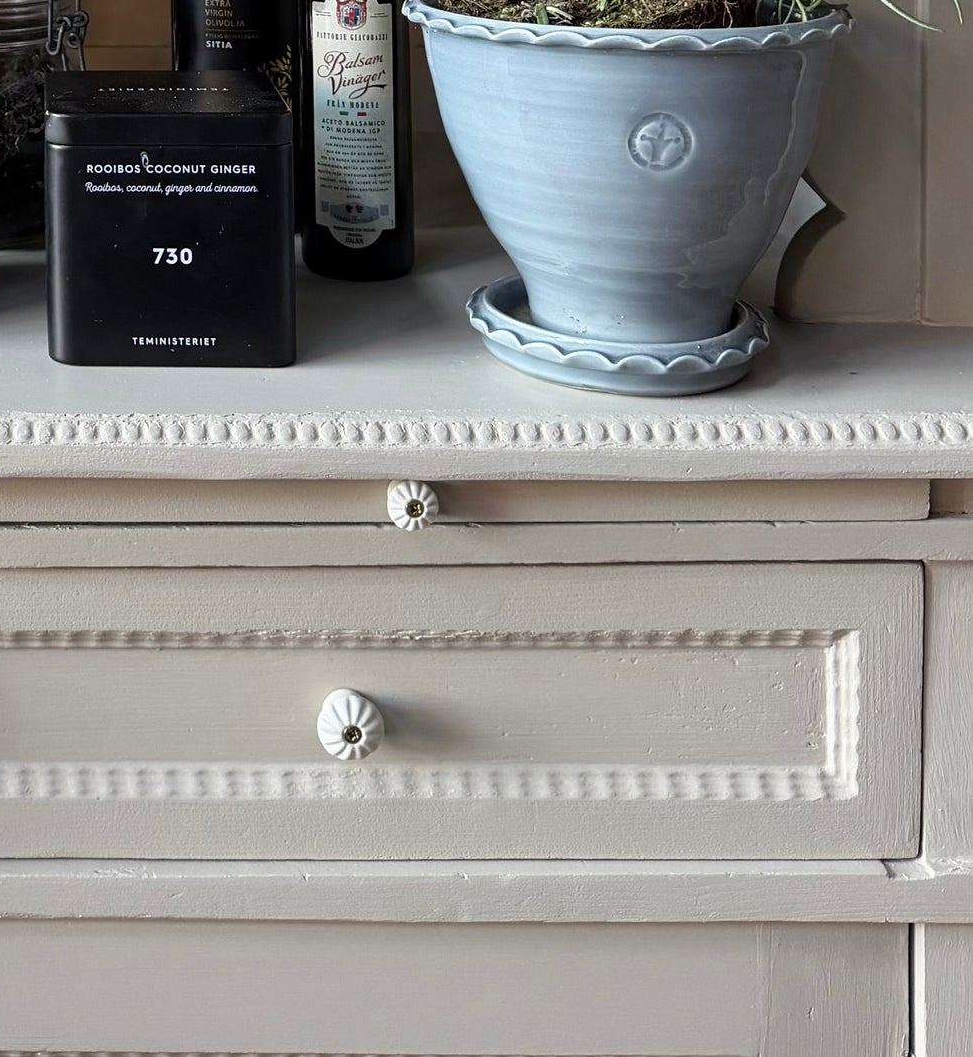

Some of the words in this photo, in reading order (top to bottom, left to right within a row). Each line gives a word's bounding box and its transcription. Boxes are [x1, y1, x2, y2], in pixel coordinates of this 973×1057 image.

[204, 0, 232, 8] EXTRA
[205, 9, 233, 18] VIRGIN
[205, 40, 233, 49] SITIA
[317, 50, 384, 78] Balsam
[329, 69, 387, 100] Vinäger
[326, 99, 345, 108] FRÅN
[350, 101, 379, 109] MODENA
[321, 118, 343, 126] ACETO
[86, 163, 141, 174] ROOIBOS
[146, 163, 206, 174] COCONUT
[210, 163, 256, 174] GINGER
[85, 181, 124, 194] Rooibos,
[126, 182, 163, 194] coconut,
[165, 183, 194, 196] ginger
[195, 182, 213, 193] and
[214, 183, 259, 193] cinnamon.
[152, 247, 193, 265] 730
[132, 336, 217, 346] TEMINISTERIET
